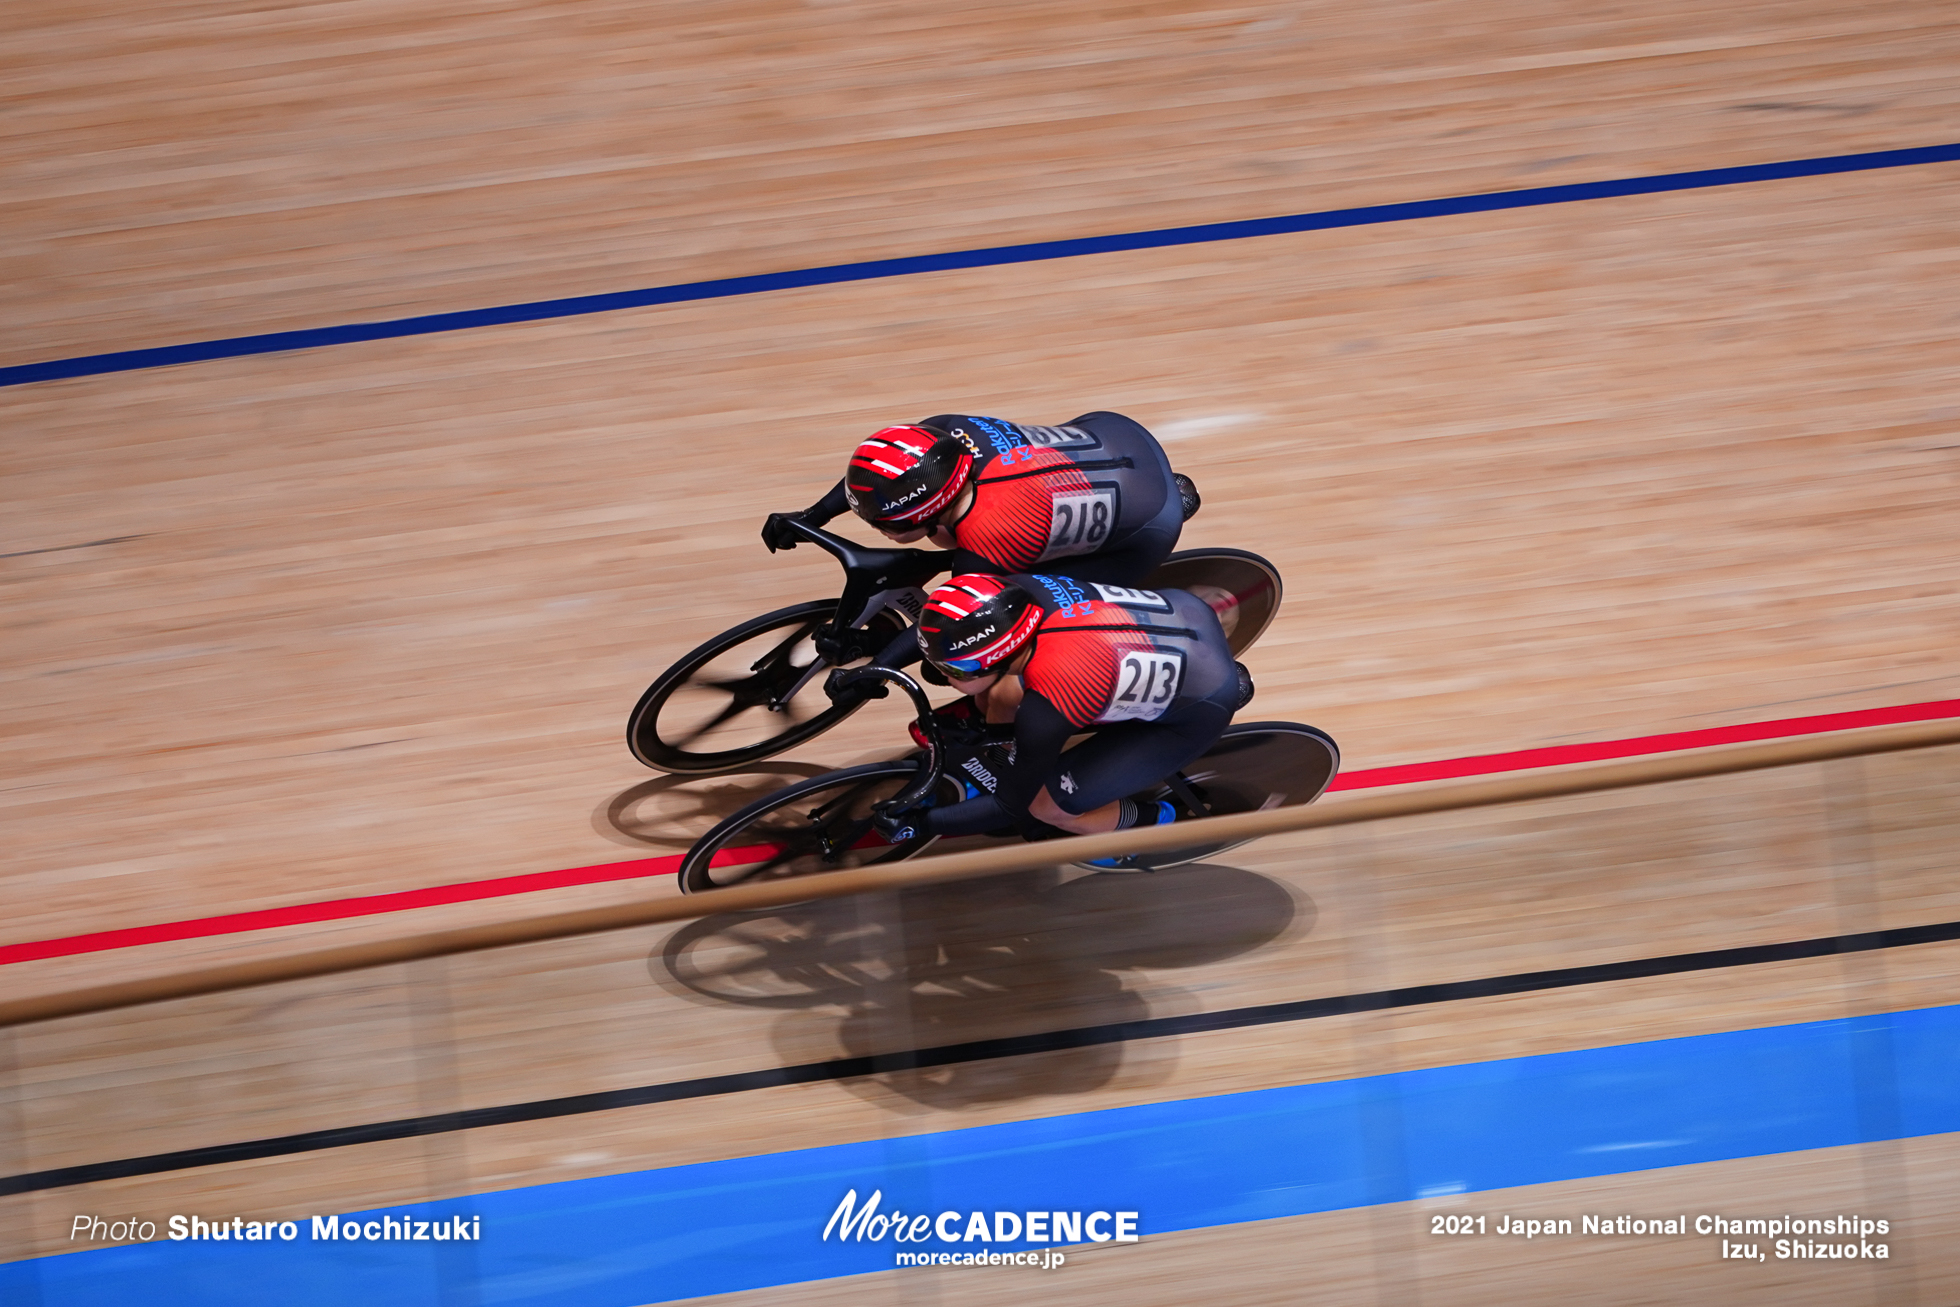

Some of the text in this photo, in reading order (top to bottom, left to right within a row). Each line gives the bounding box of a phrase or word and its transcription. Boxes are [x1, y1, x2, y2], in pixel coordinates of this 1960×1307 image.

[968, 416, 1015, 466] Rakuten
[882, 483, 927, 511] JAPAN
[917, 463, 969, 521] Kabuto
[1051, 501, 1108, 546] 218
[1032, 574, 1076, 618] Rakuten
[949, 624, 996, 651] JAPAN
[986, 610, 1040, 665] Kabuto
[1117, 658, 1177, 704] 213
[961, 757, 999, 794] BRIDGE
